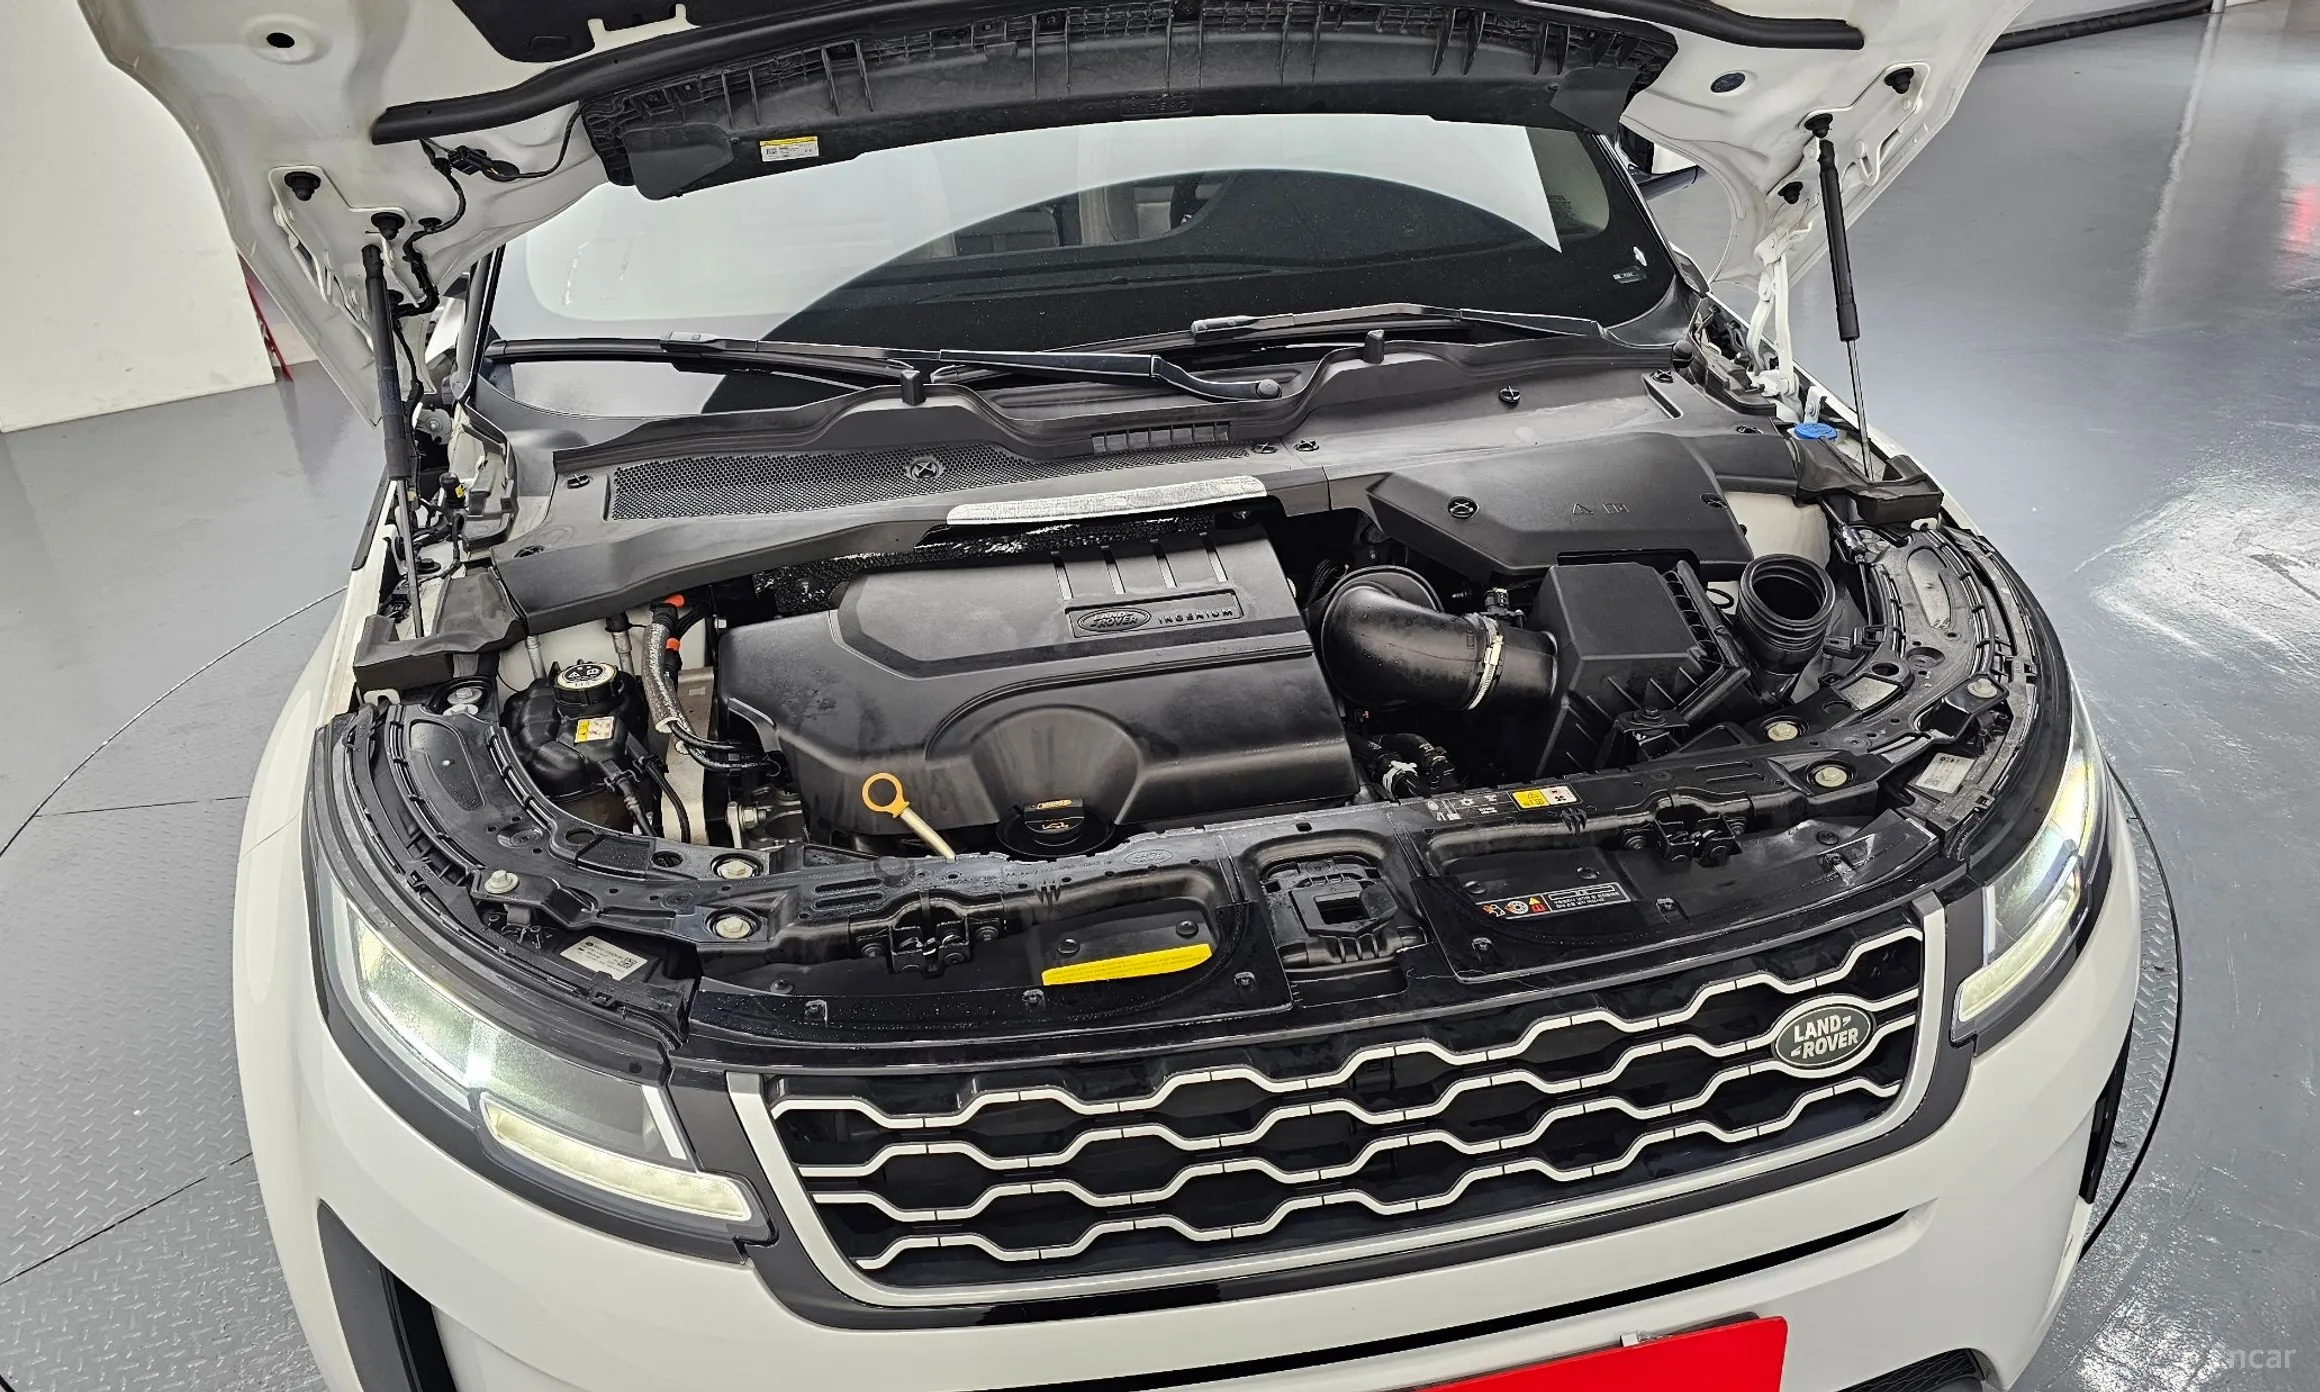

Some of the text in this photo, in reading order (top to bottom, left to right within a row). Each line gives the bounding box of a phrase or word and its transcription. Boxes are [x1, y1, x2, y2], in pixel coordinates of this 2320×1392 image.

[1094, 611, 1126, 621] LAND
[1098, 616, 1138, 628] ROVER
[1158, 609, 1233, 624] INGENIUM
[1794, 1014, 1842, 1043] LAND
[1802, 1028, 1859, 1059] ROVER
